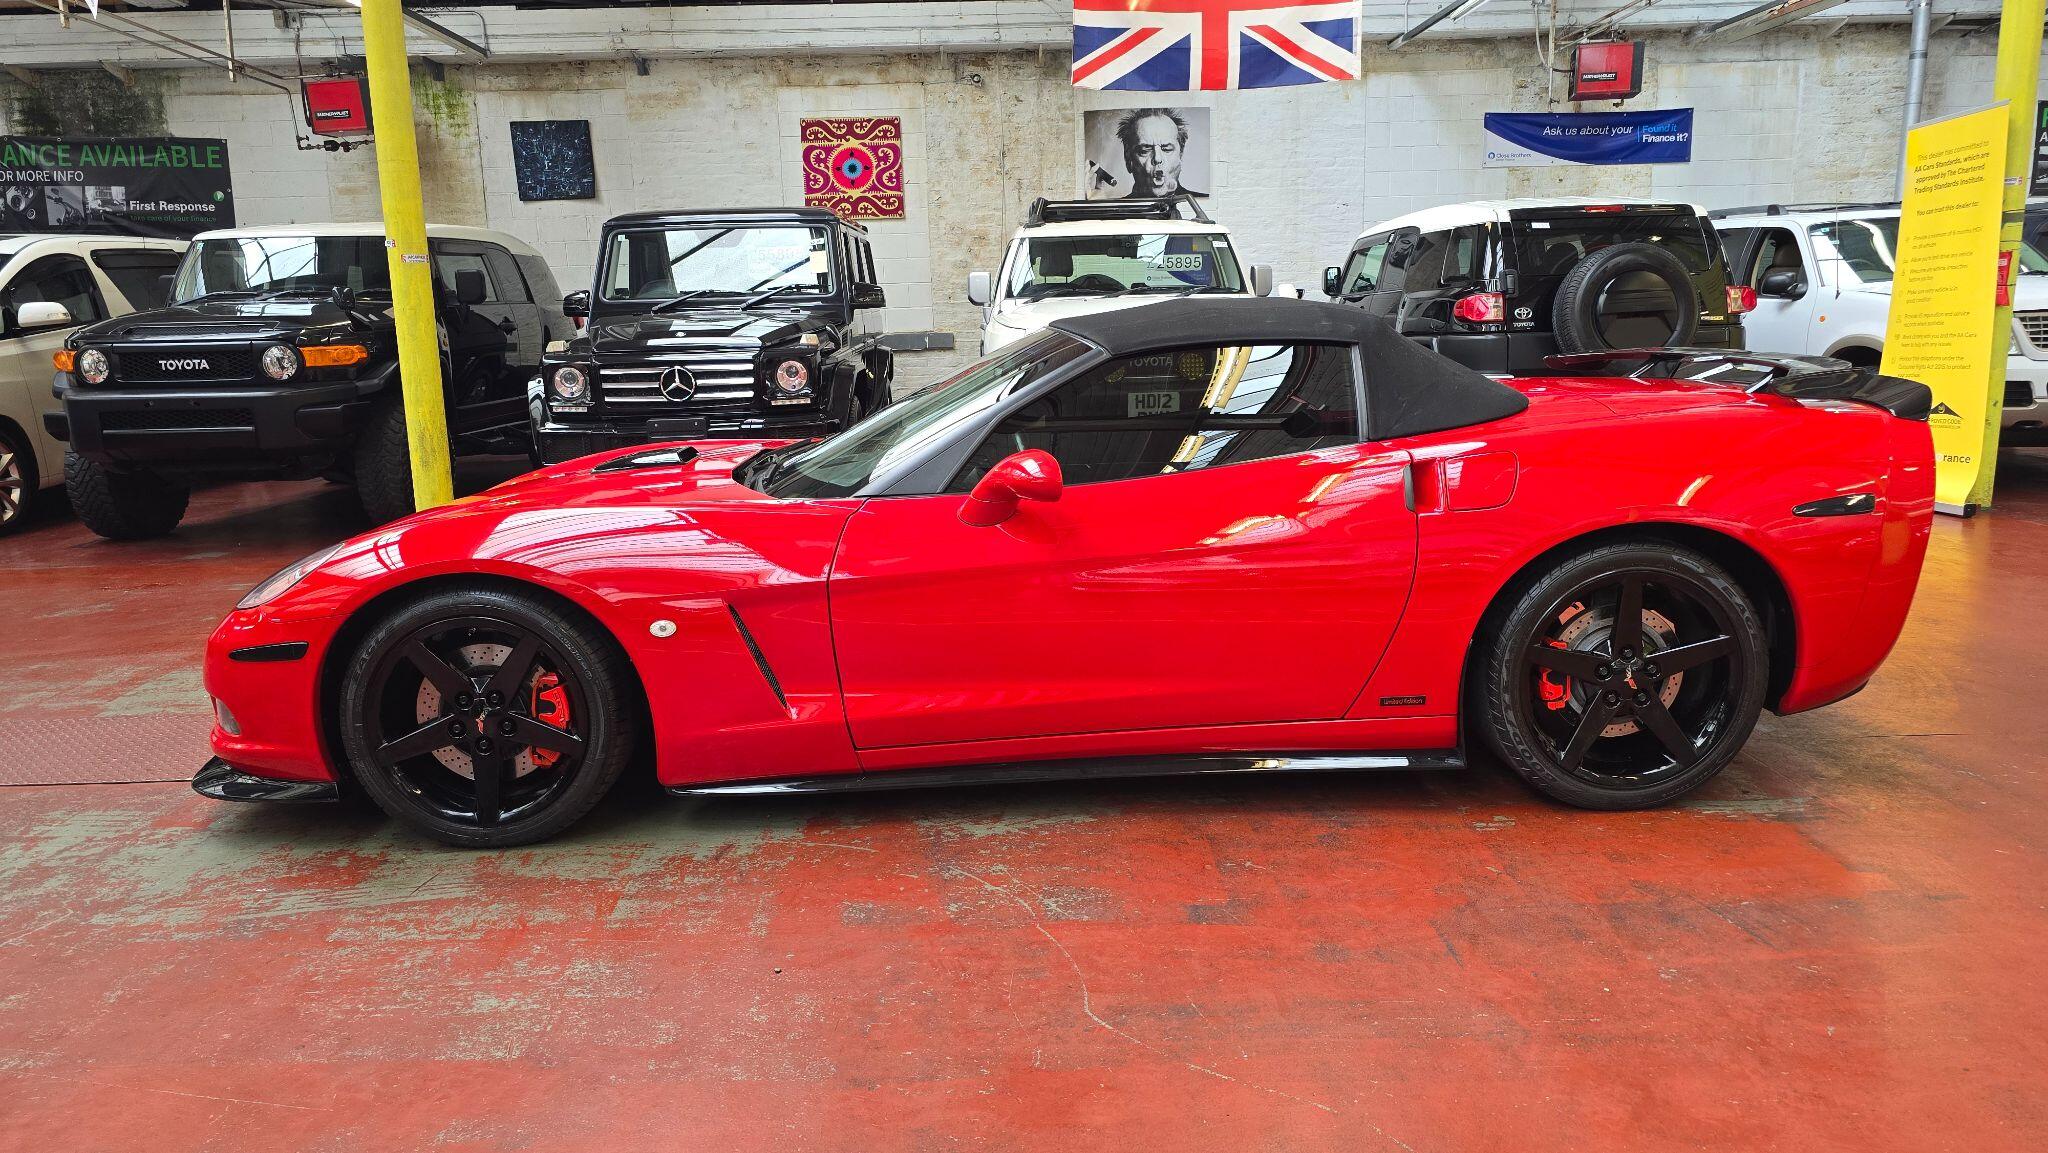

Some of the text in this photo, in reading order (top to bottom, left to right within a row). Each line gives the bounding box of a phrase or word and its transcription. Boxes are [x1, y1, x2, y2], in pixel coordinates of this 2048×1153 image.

[1542, 126, 1633, 137] Ask us about your
[1642, 124, 1677, 133] Found it
[1642, 132, 1689, 143] Finance it?
[3, 145, 224, 168] ANCE AVAILABLE
[1923, 164, 1934, 172] Cars
[16, 170, 51, 182] MORE
[53, 170, 84, 182] INFO
[1914, 183, 1933, 194] Trading
[1934, 180, 1959, 190] Standards
[129, 201, 216, 213] First Response
[159, 359, 210, 371] TOYOTA
[1135, 393, 1172, 409] HD12
